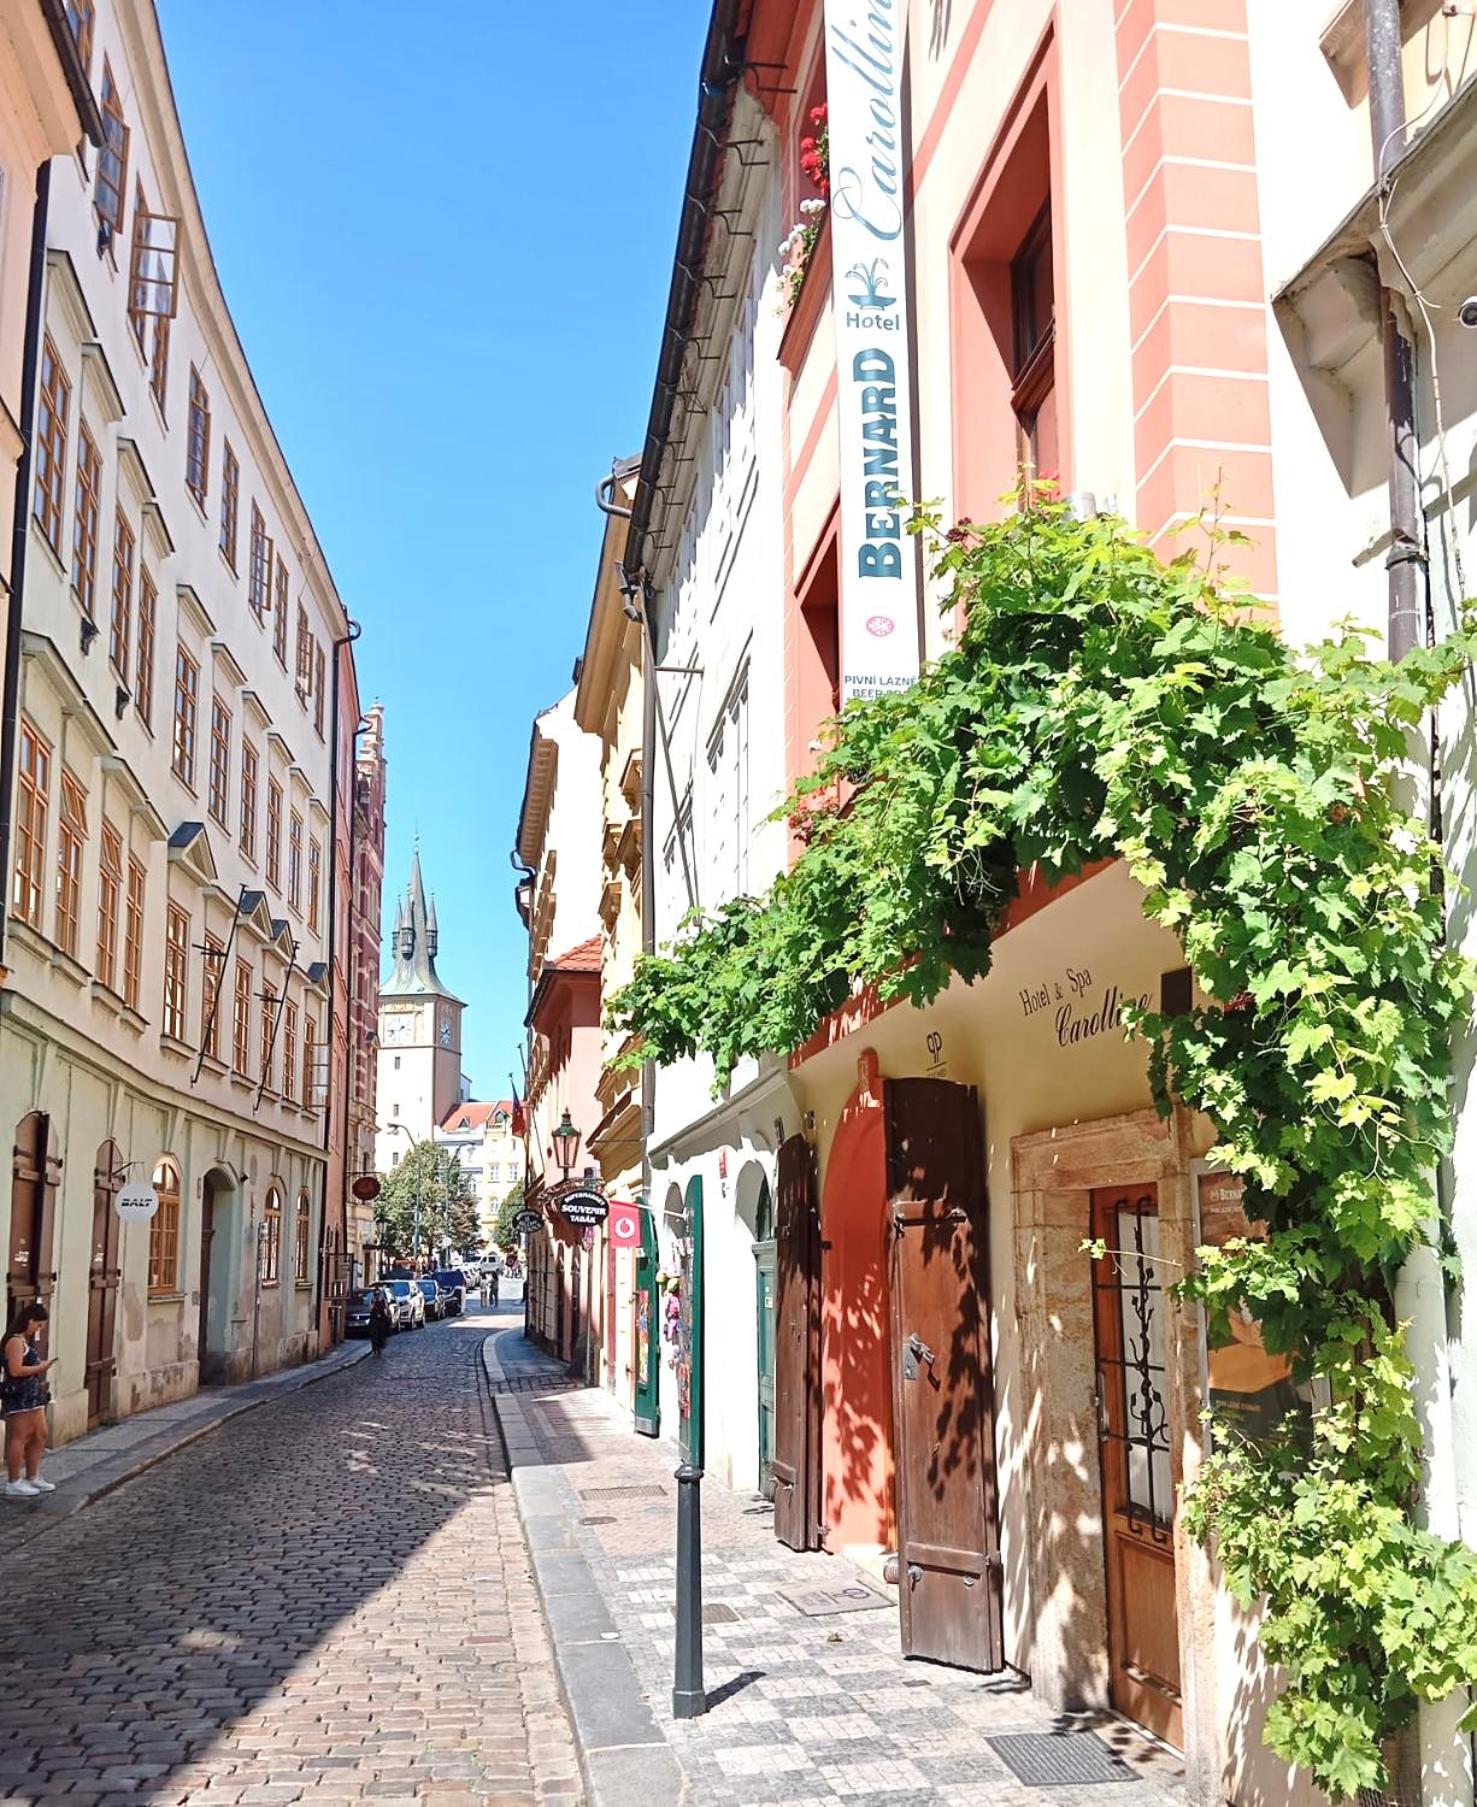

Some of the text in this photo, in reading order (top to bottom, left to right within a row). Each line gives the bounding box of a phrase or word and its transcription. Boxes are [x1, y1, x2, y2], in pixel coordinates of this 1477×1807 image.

[846, 312, 900, 331] Hotel
[852, 347, 903, 580] BERNARD
[1019, 968, 1093, 1016] Hotel & Spa
[561, 1204, 607, 1216] SOUVENIR
